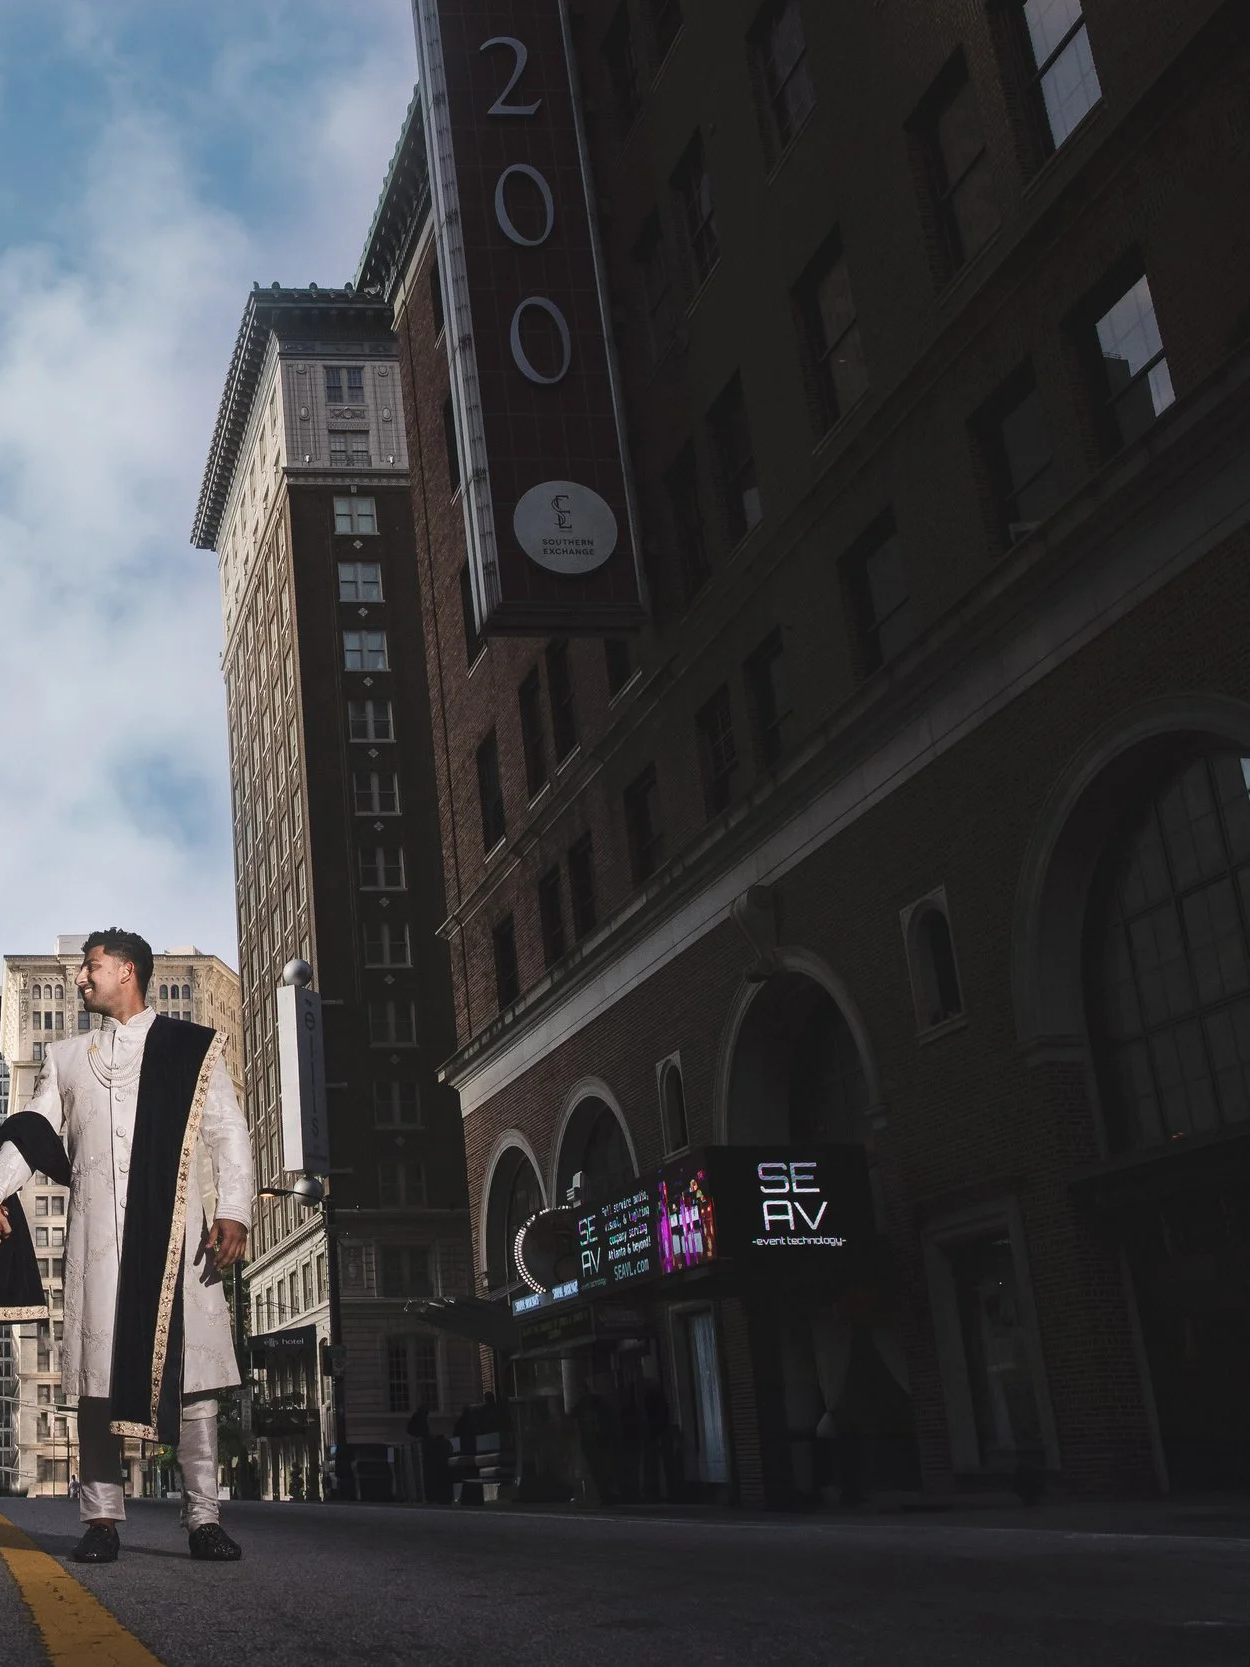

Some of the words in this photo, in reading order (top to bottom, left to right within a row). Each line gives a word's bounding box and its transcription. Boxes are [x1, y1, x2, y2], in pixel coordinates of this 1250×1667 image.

[479, 36, 572, 385] 200
[542, 538, 594, 546] SOUTHERN
[543, 548, 595, 556] EXCHANGE
[757, 1162, 820, 1193] SE
[578, 1214, 598, 1247] SE
[762, 1199, 828, 1231] AV
[581, 1246, 601, 1278] AV
[608, 1247, 626, 1261] Atlanta
[632, 1235, 651, 1253] beyond!
